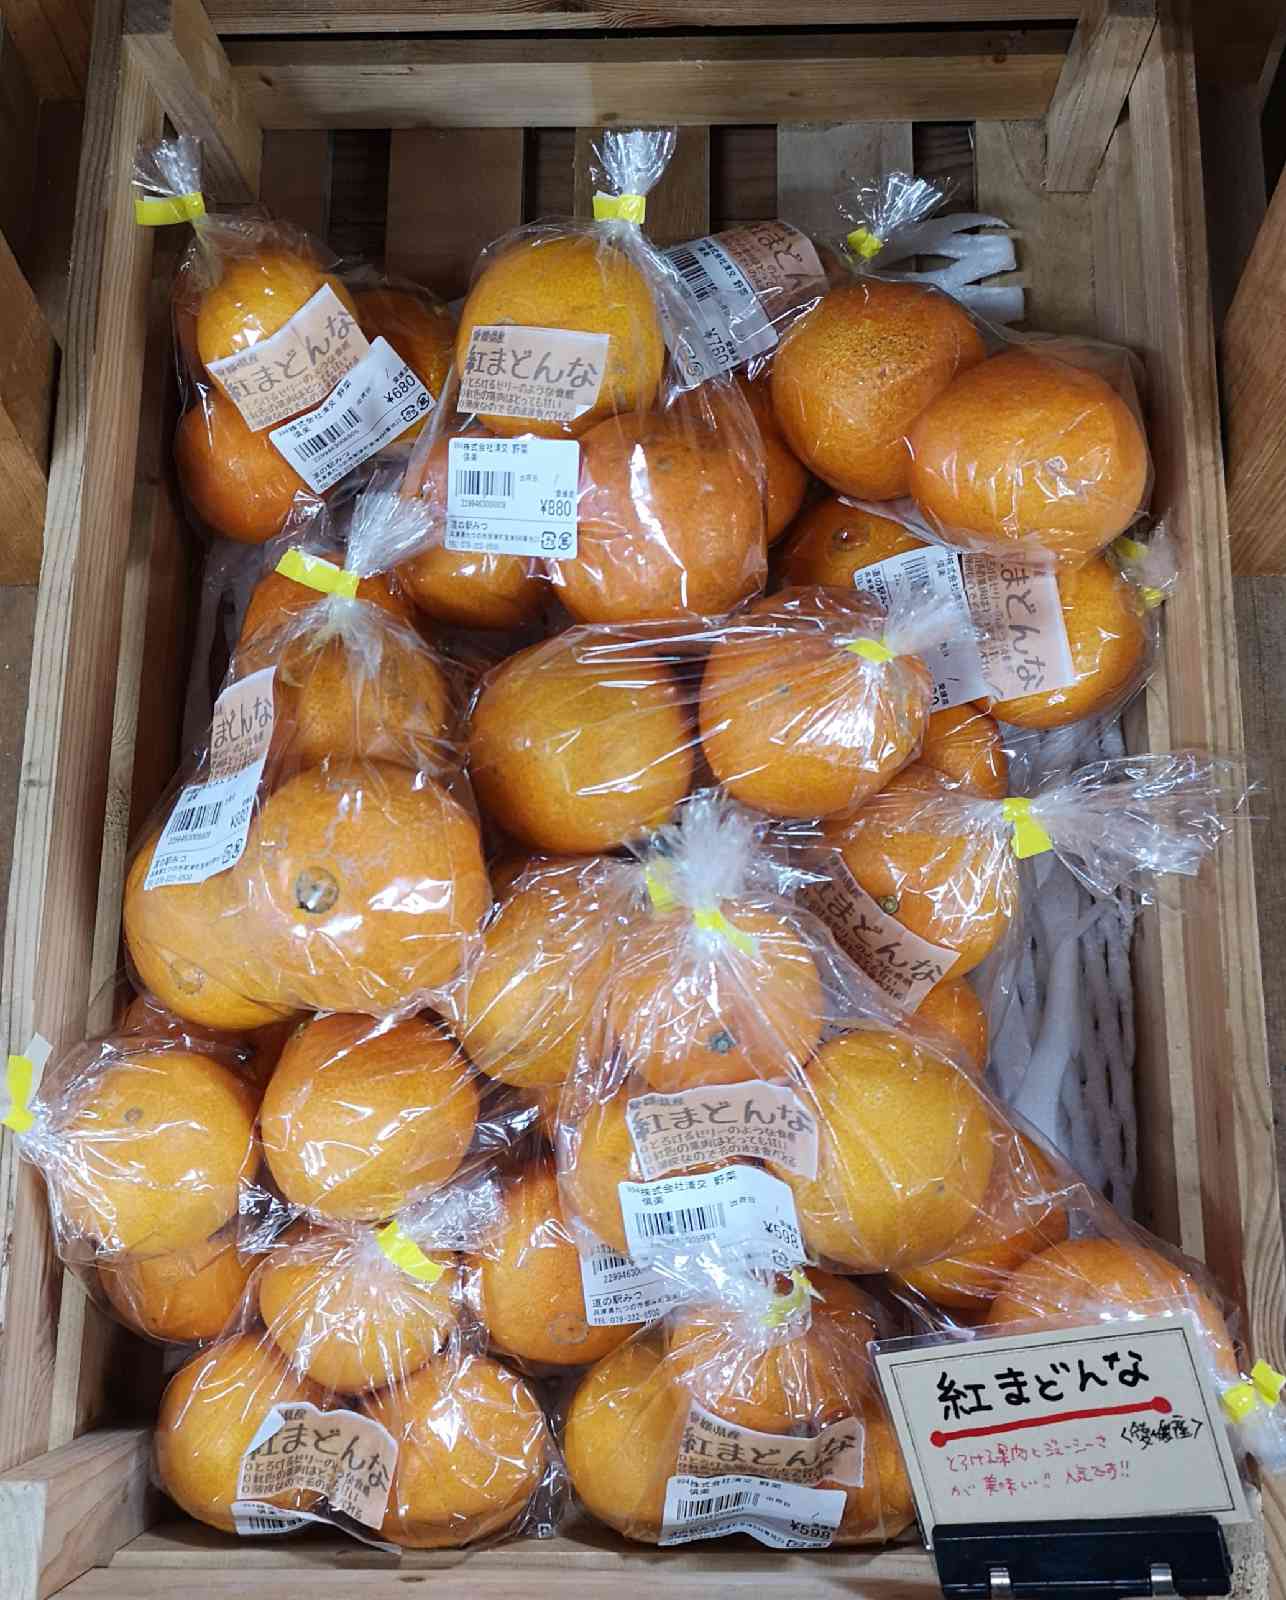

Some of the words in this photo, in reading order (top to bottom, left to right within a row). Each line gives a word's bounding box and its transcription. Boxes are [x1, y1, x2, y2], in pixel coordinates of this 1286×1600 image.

[223, 311, 354, 398] 紅まどんな
[465, 345, 599, 388] 紅まどんな
[384, 374, 416, 404] ¥680
[540, 499, 572, 517] ¥880
[632, 1100, 815, 1141] 紅まどんな
[592, 1290, 643, 1307] 道の駅みつ
[936, 1350, 1149, 1421] 紅まどんな
[681, 1426, 856, 1468] 紅まどんな
[790, 1519, 832, 1540] ¥598
